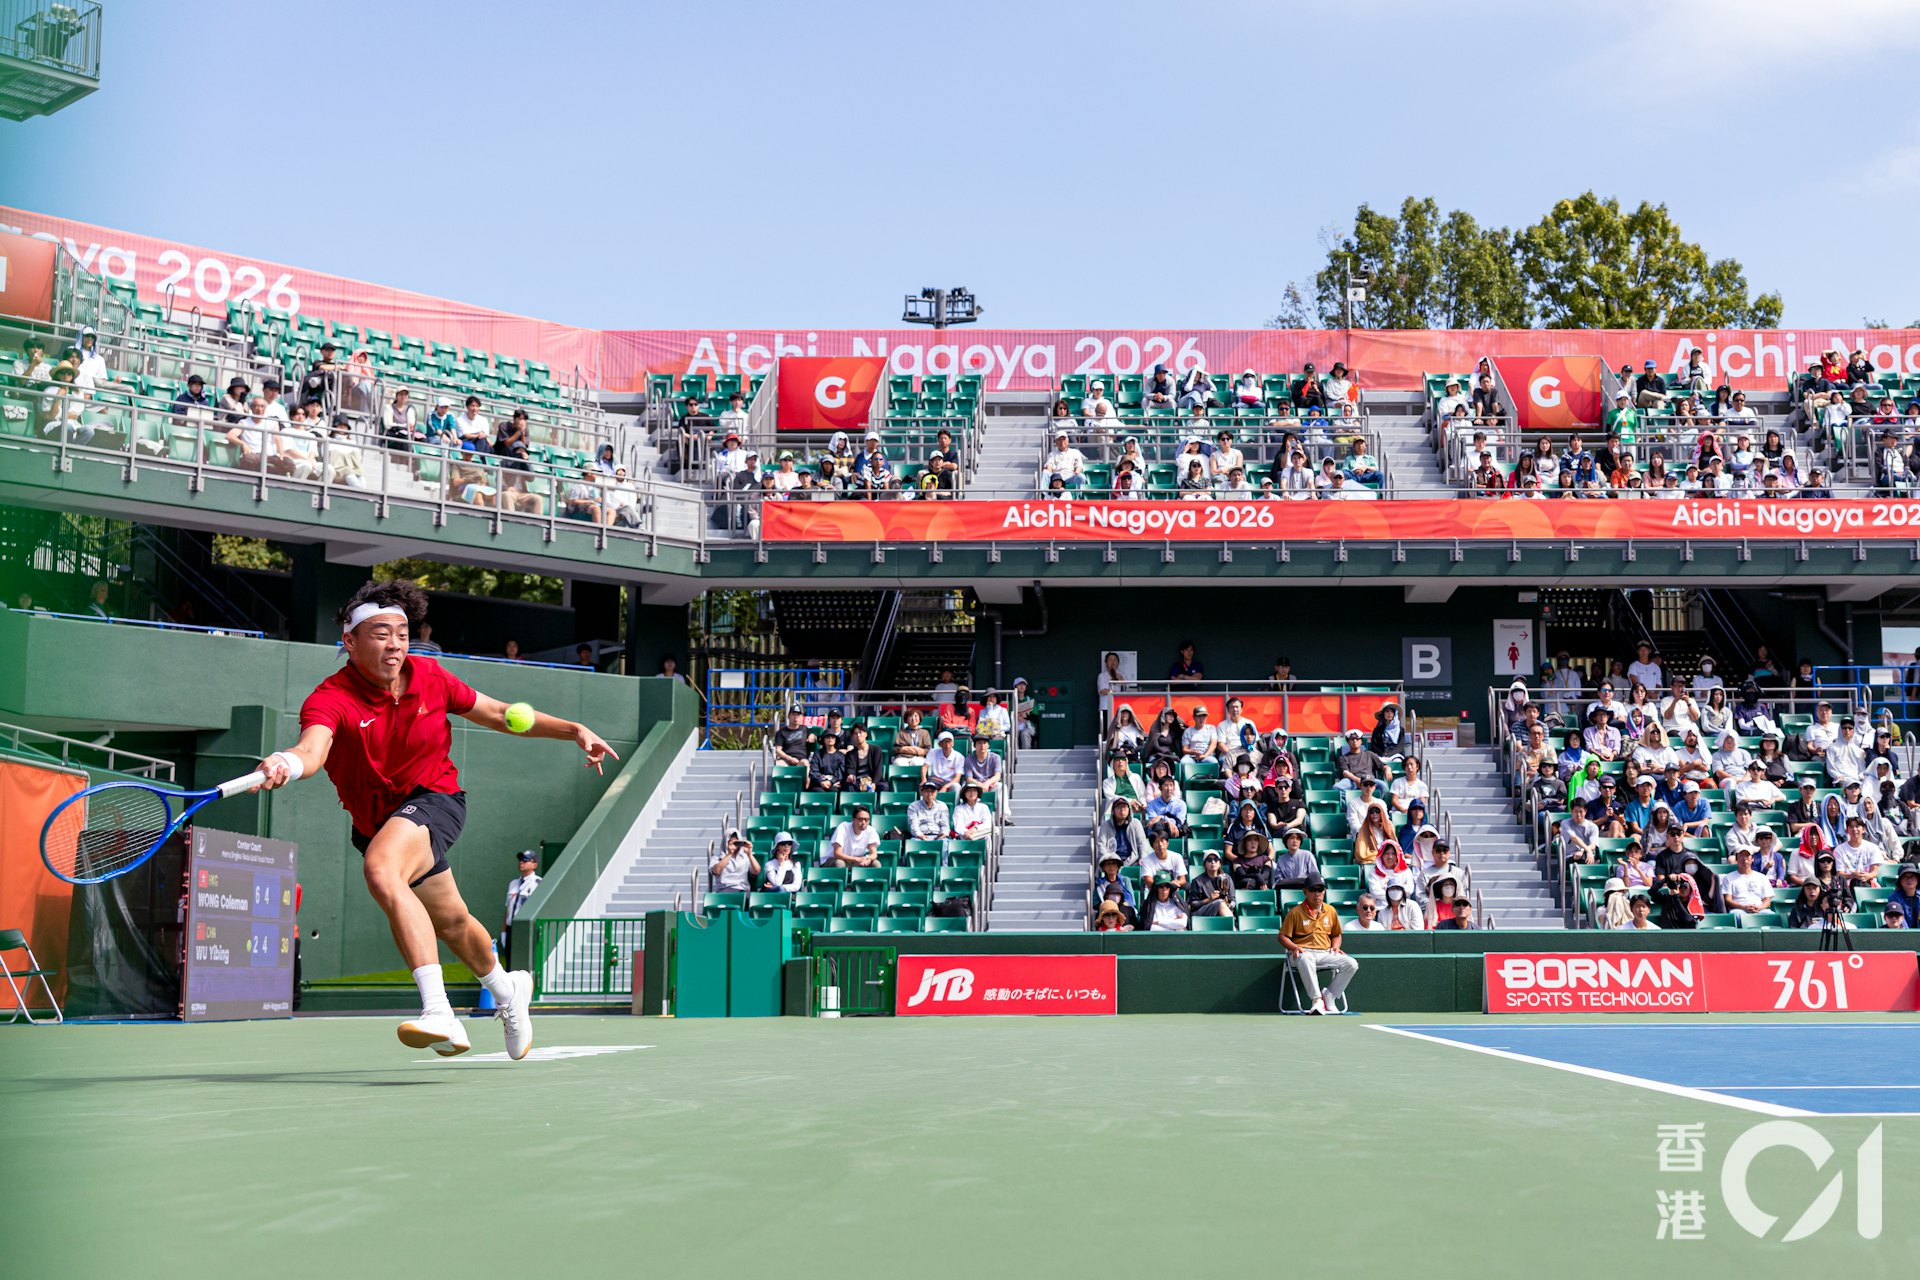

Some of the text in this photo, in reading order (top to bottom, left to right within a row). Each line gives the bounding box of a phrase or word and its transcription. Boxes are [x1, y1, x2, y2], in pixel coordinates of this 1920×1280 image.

[156, 250, 300, 316] 2026
[1074, 337, 1207, 376] 2026
[815, 376, 846, 408] G
[1530, 376, 1560, 407] G
[1003, 504, 1274, 534] Aichi-Nagoya 2026
[1672, 502, 1864, 532] Aichi-Nagoya
[1411, 644, 1441, 679] B
[198, 893, 248, 911] WONG Coleman
[255, 886, 270, 905] 6 4
[282, 890, 291, 906] 40
[196, 944, 230, 964] WU Yibing
[253, 935, 268, 953] 2 4
[281, 937, 289, 953] 30
[907, 968, 975, 1007] JTB
[1497, 958, 1694, 988] BORNAN
[983, 988, 1107, 1001] 感動のそばに、いつも。
[1506, 991, 1694, 1007] SPORTS TECHNOLOGY
